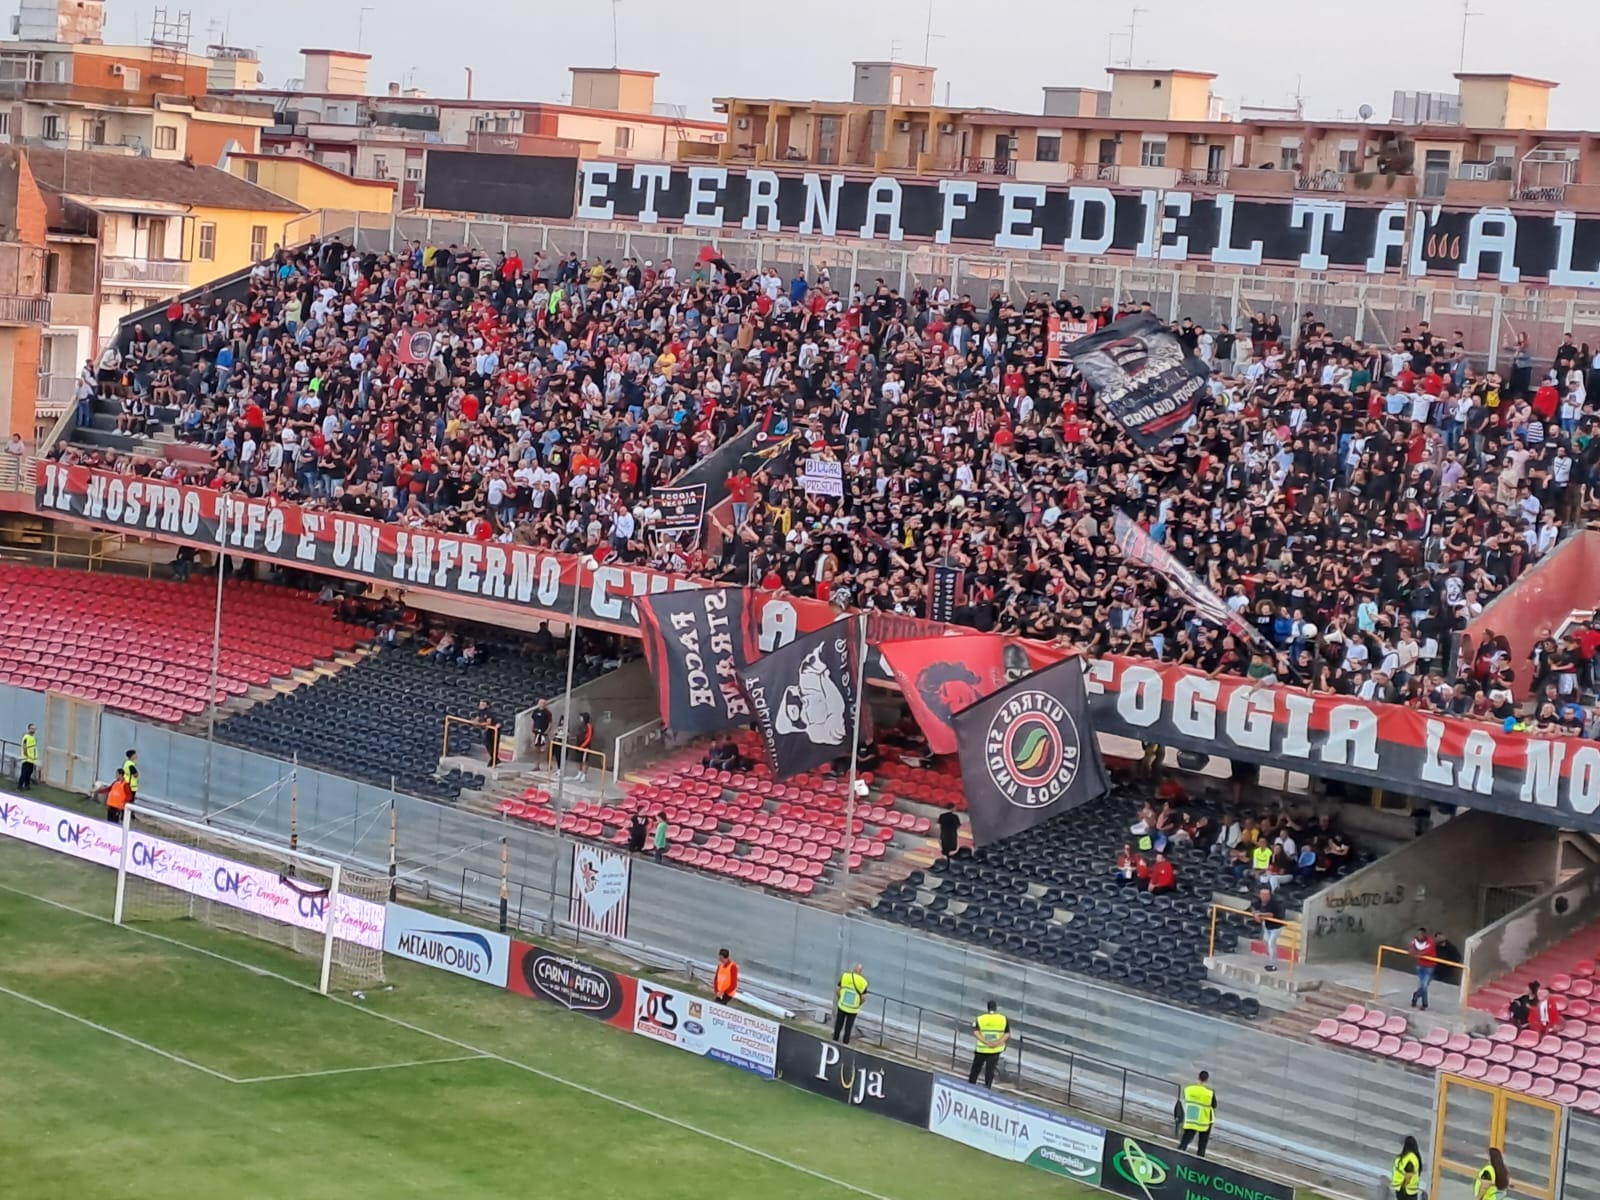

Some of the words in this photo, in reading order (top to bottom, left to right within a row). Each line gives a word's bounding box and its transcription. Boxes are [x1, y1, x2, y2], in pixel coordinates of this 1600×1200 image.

[41, 464, 72, 511] IL
[83, 475, 201, 536] NOSTRO
[332, 519, 380, 574] UN
[393, 531, 562, 607] INFERNO
[1081, 657, 1380, 770] FOGGIA
[1421, 718, 1496, 795] LA
[398, 931, 481, 974] METAUROBUS
[538, 962, 570, 986] CARNI
[574, 975, 605, 998] AFFINI
[953, 1101, 1030, 1141] RIABILITA
